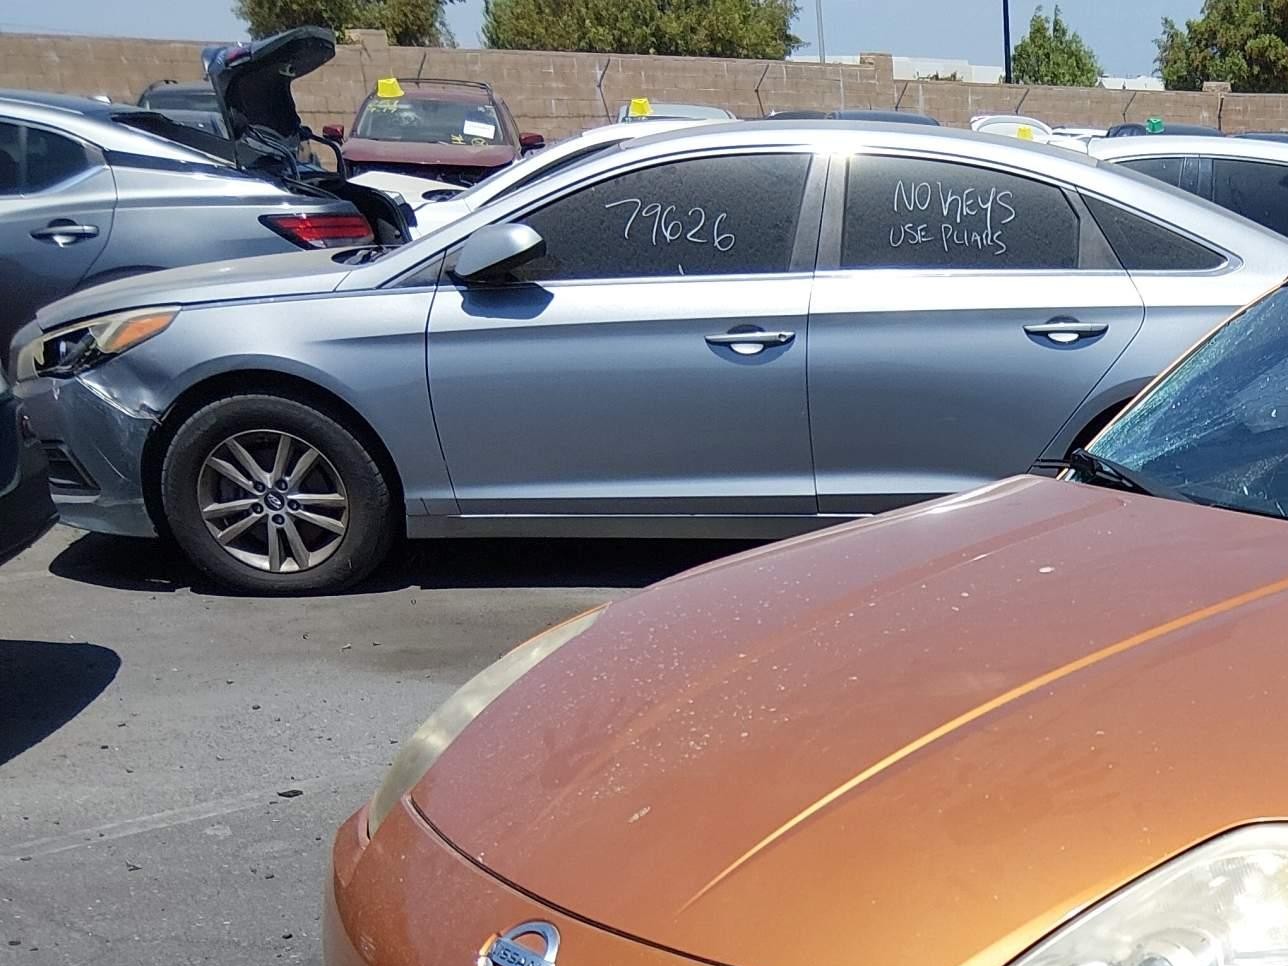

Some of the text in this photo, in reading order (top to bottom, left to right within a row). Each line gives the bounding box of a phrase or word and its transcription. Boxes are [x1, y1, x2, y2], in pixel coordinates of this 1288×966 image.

[604, 198, 735, 251] 79626
[894, 179, 1016, 231] NO KEYS
[889, 223, 934, 247] USE
